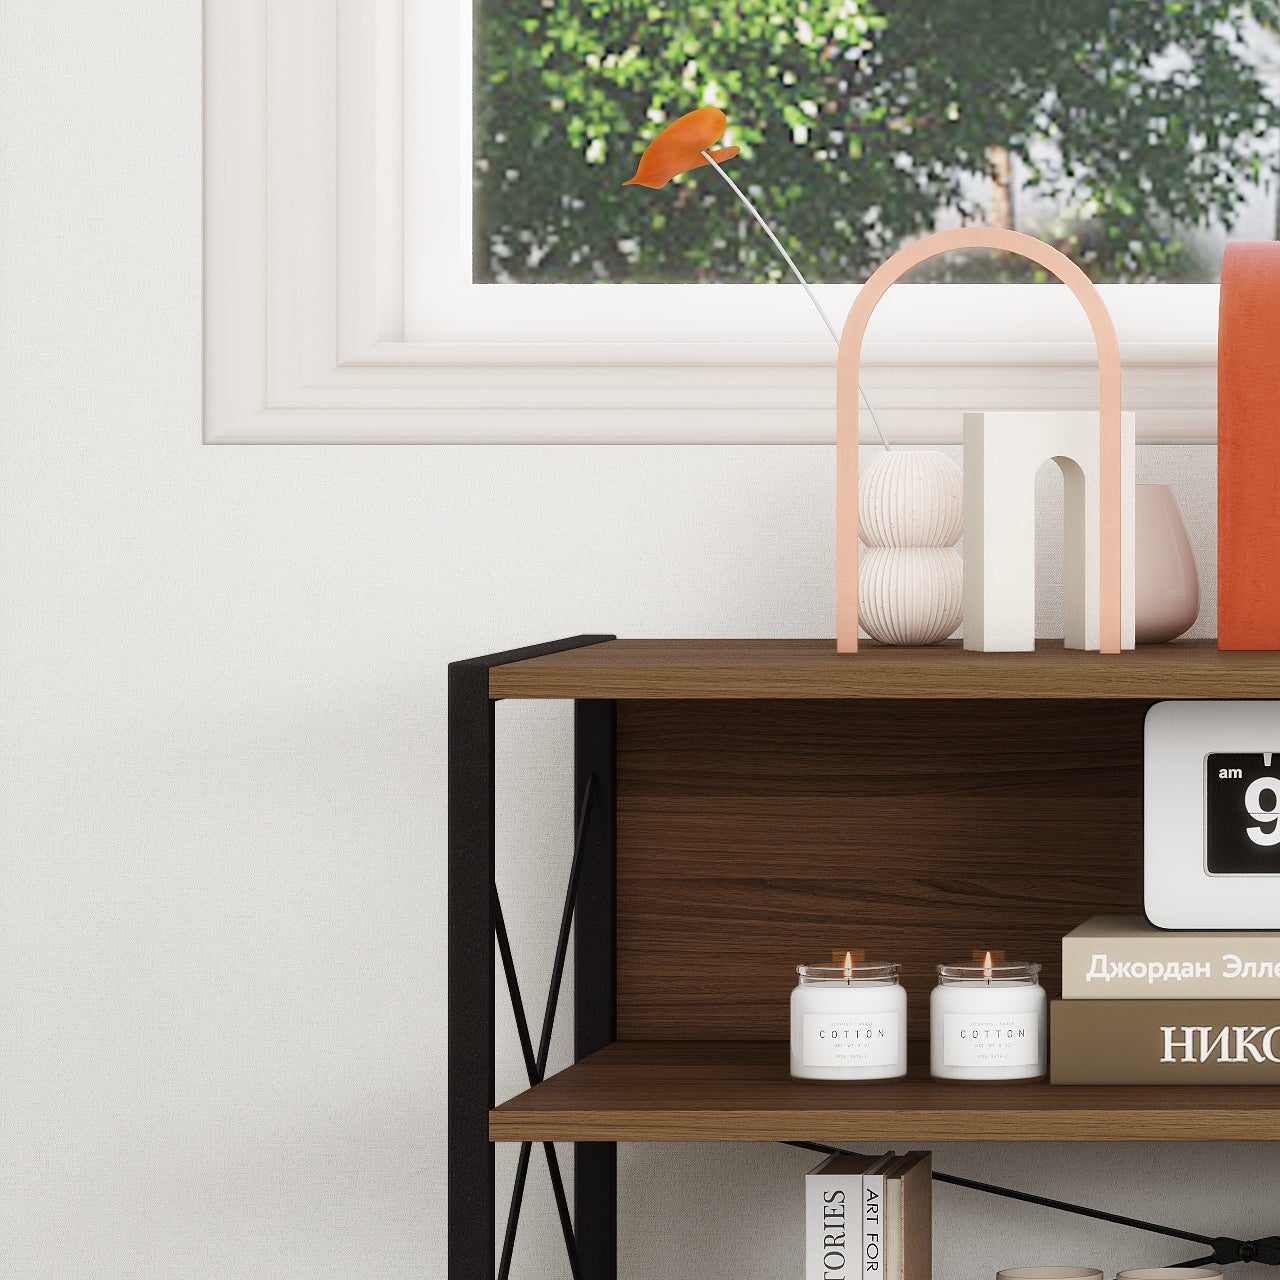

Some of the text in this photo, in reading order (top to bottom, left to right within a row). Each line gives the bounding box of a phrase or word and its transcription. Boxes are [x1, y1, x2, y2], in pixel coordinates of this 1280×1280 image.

[1218, 768, 1243, 779] am
[1085, 954, 1211, 984] Джордан
[819, 1029, 885, 1039] COTTON
[960, 1029, 1025, 1039] COTTON
[866, 1188, 879, 1225] ART
[866, 1233, 879, 1272] FOR
